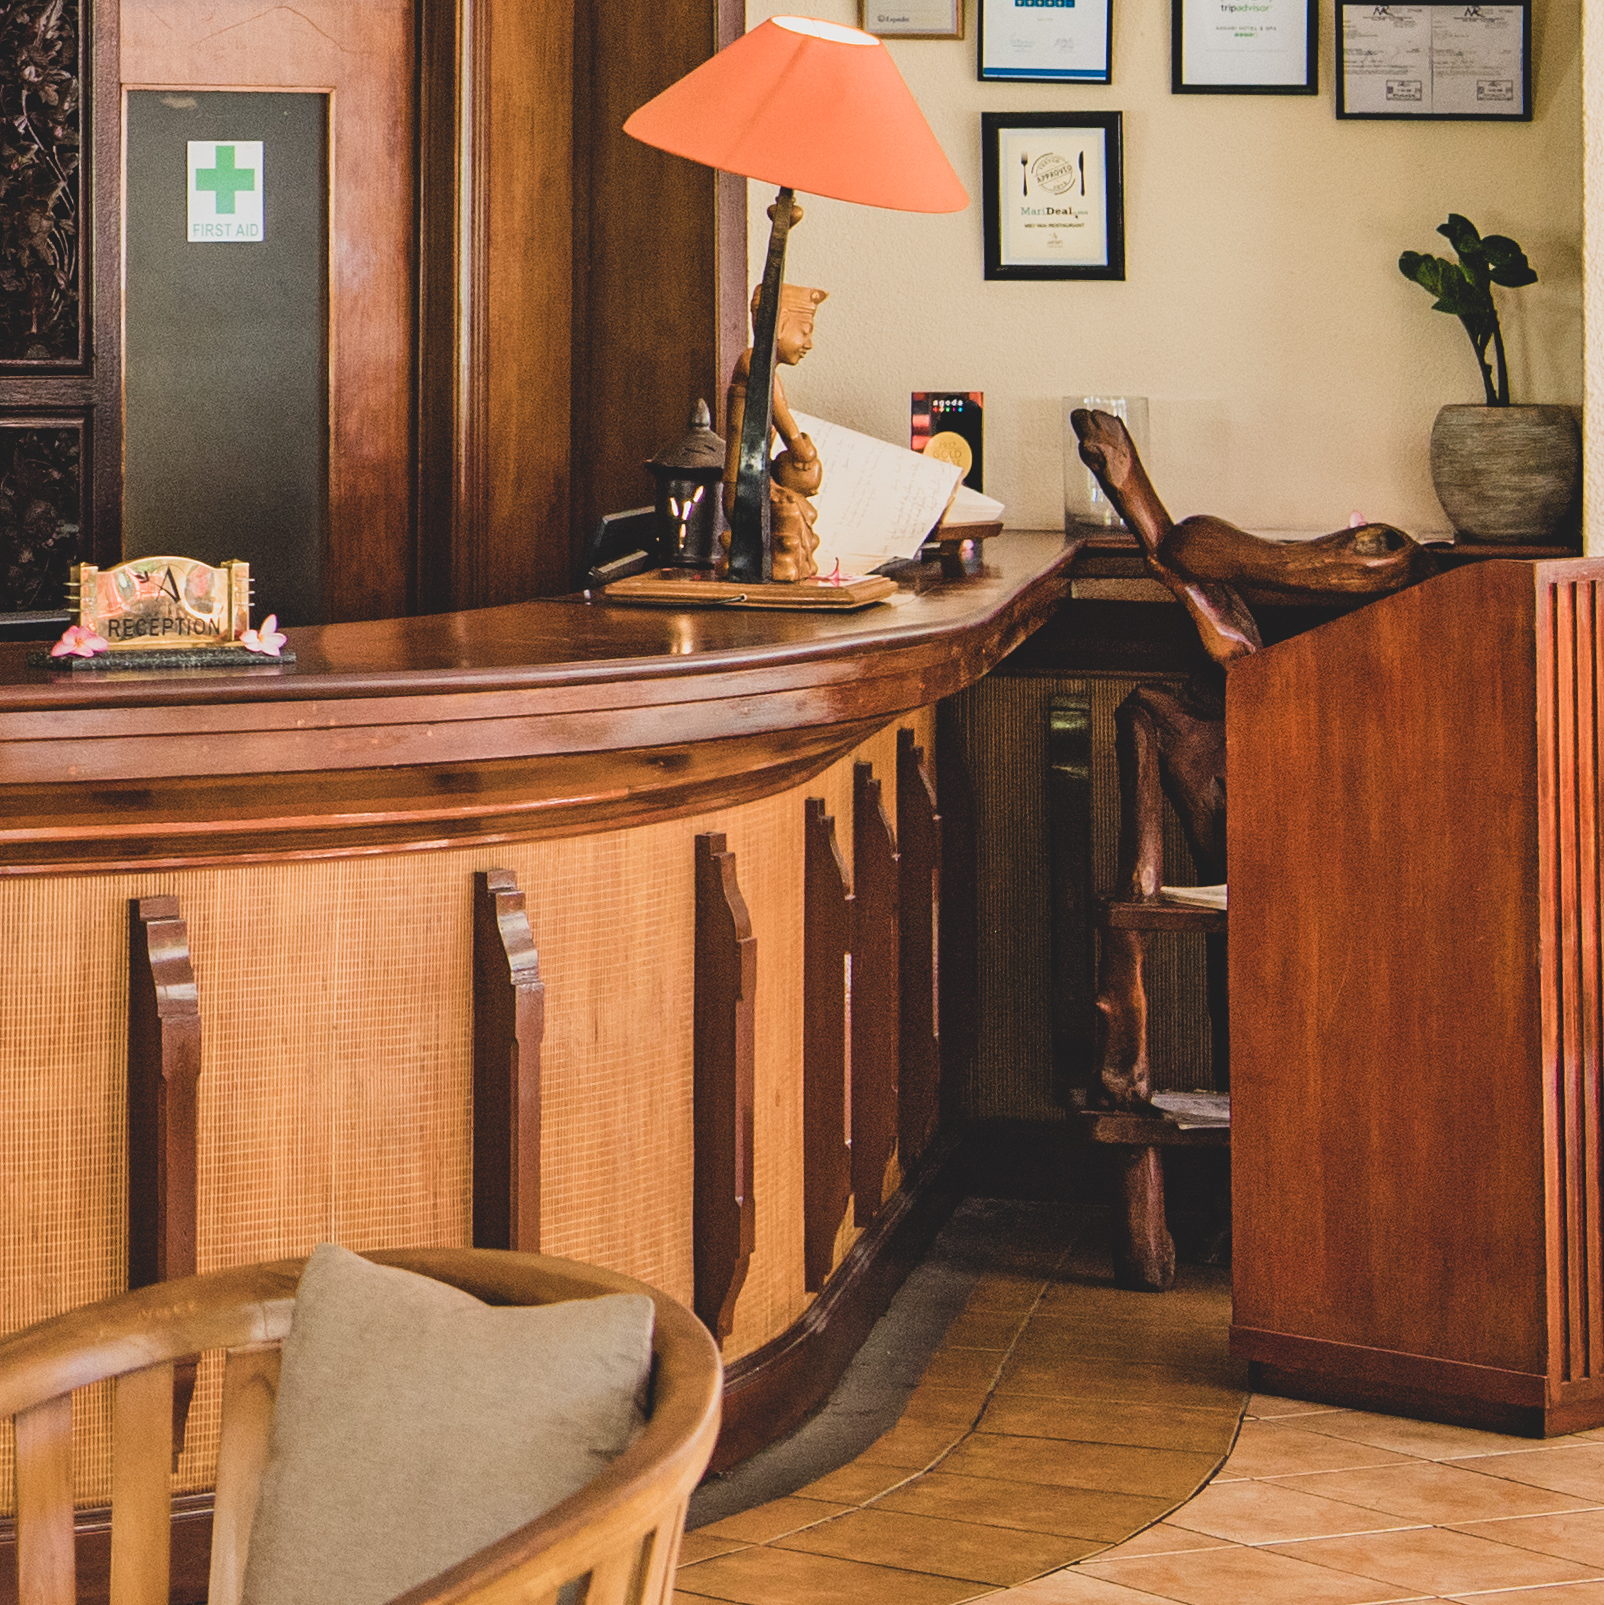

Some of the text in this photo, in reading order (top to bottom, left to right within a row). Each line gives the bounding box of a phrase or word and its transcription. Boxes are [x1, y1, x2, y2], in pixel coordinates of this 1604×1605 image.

[1221, 4, 1270, 13] tripadvisor
[1037, 164, 1073, 183] APPROVED
[192, 223, 259, 237] FIRST AID
[932, 398, 964, 408] agoda
[932, 449, 962, 459] GOLD
[155, 565, 181, 604] A
[108, 617, 221, 638] RECEPTION
